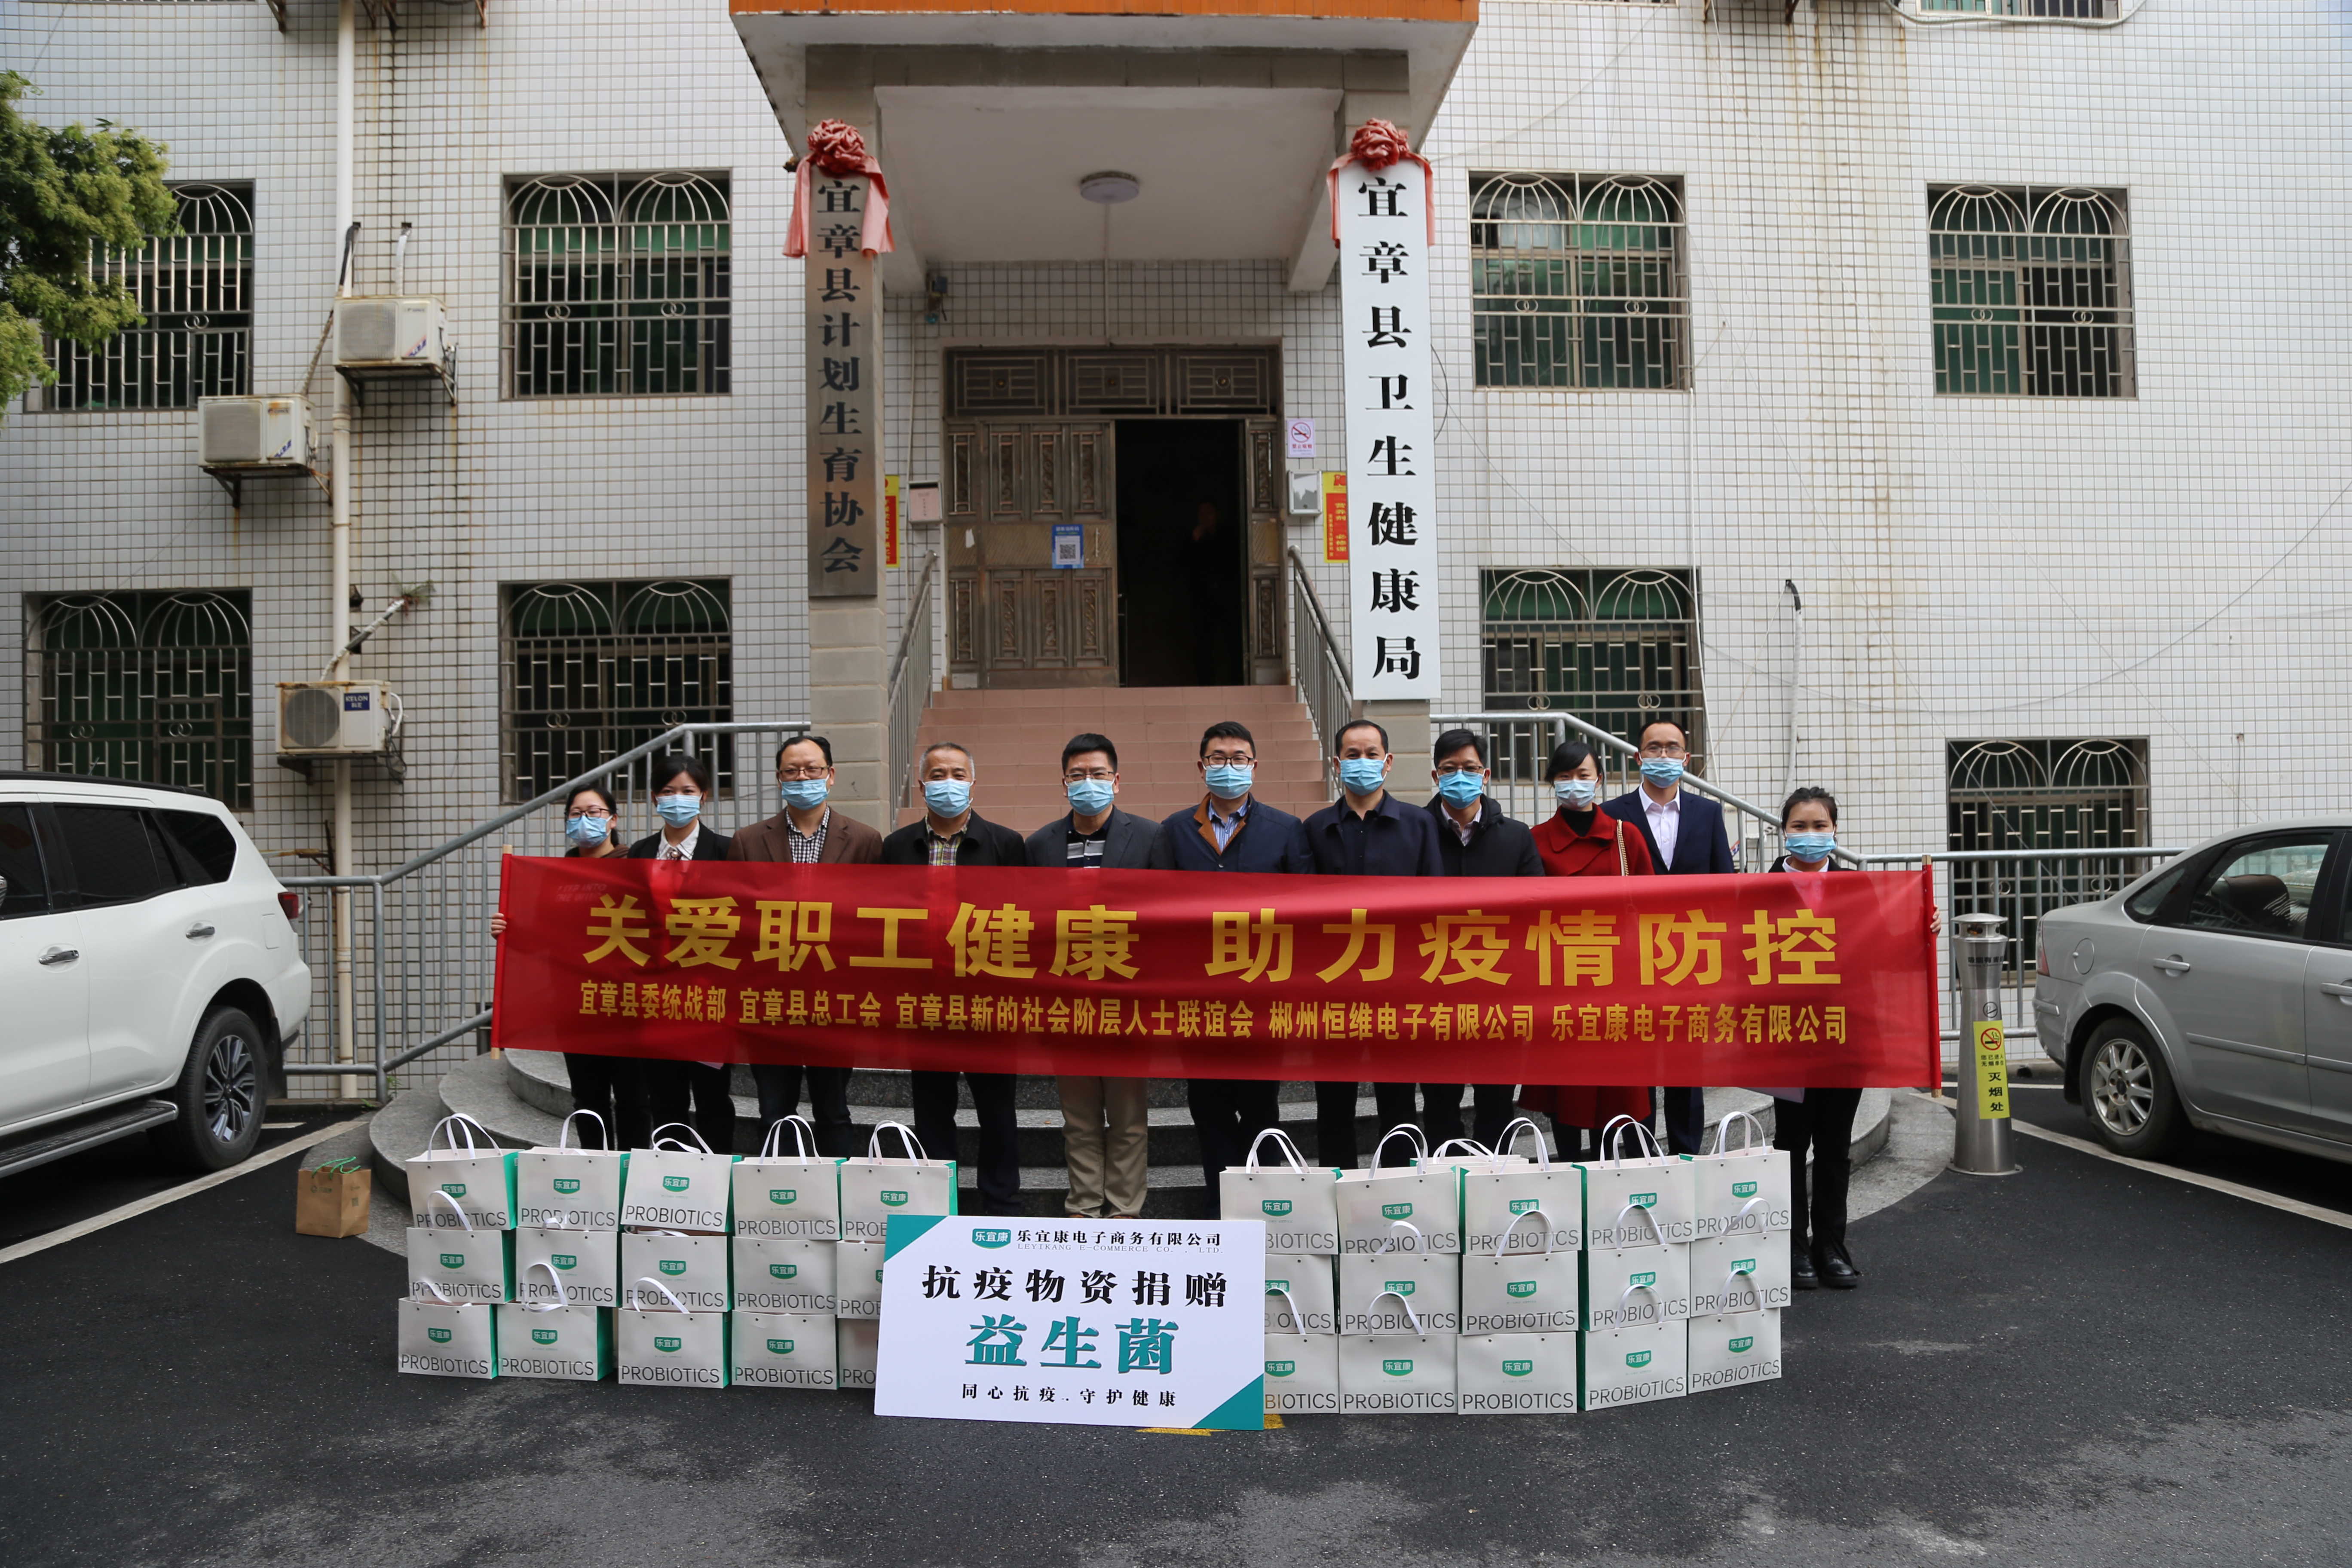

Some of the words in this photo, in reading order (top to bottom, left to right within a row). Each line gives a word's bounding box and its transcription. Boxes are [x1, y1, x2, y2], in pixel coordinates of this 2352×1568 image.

[816, 180, 864, 573] 宜章县计划生育协会
[1358, 178, 1421, 681] 宜章县卫生健康局
[582, 894, 1140, 980] 关爱职工健康
[1204, 907, 1843, 987] 助力疫情防控
[579, 980, 726, 1024] 宜章县委统战部
[739, 987, 882, 1028] 宜章县总工会
[896, 992, 1254, 1038] 宜章县新的社会阶层人士联谊会
[1268, 1001, 1535, 1042] 郴州恒维电子有限公司
[1551, 1003, 1847, 1045] 乐宜康电子商务有限公司
[1988, 1072, 2004, 1112] 灭烟处
[555, 1181, 578, 1190] 乐宜康
[664, 1178, 687, 1188] 乐宜康
[444, 1185, 465, 1194] 乐宜康
[1733, 1184, 1755, 1194] 乐宜康
[771, 1191, 795, 1200] 乐宜康
[882, 1193, 906, 1201] 乐宜康
[1631, 1194, 1655, 1204] 乐宜康
[1264, 1202, 1289, 1211] 乐宜康
[1384, 1205, 1410, 1216] 乐宜康
[1511, 1201, 1537, 1211] 乐宜康
[625, 1205, 723, 1227] PROBIOTICS
[738, 1220, 836, 1235] PROBIOTICS
[975, 1231, 1008, 1243] 乐宜康
[1017, 1230, 1221, 1246] 乐宜康电子商务有限公司
[441, 1256, 462, 1265] 乐宜康
[553, 1256, 575, 1266] 乐宜康
[1733, 1261, 1755, 1271] 乐宜康
[661, 1262, 684, 1271] 乐宜康
[771, 1266, 795, 1275] 乐宜康
[1632, 1274, 1654, 1284] 乐宜康
[922, 1265, 1227, 1308] 抗疫物资捐赠
[1387, 1283, 1412, 1292] 乐宜康
[1509, 1282, 1535, 1293] 乐宜康
[738, 1292, 836, 1309] PROBIOTICS
[1345, 1313, 1456, 1330] PROBIOTICS
[1467, 1310, 1575, 1331] PROBIOTICS
[429, 1330, 450, 1340] 乐宜康
[533, 1331, 557, 1341] 乐宜康
[656, 1339, 679, 1348] 乐宜康
[769, 1341, 792, 1350] 乐宜康
[964, 1314, 1179, 1375] 益生菌
[1730, 1338, 1752, 1349] 乐宜康
[1627, 1352, 1650, 1364] 乐宜康
[401, 1354, 489, 1374] PROBIOTICS
[502, 1358, 594, 1375] PROBIOTICS
[1266, 1363, 1293, 1372] 乐宜康
[1384, 1361, 1411, 1371] 乐宜康
[1504, 1361, 1530, 1371] 乐宜康
[622, 1365, 720, 1383] PROBIOTICS
[735, 1367, 833, 1385] PROBIOTICS
[1692, 1359, 1779, 1388] PROBIOTICS
[1589, 1377, 1684, 1405] PROBIOTICS
[1344, 1392, 1455, 1409] PROBIOTICS
[1463, 1393, 1574, 1409] PROBIOTICS
